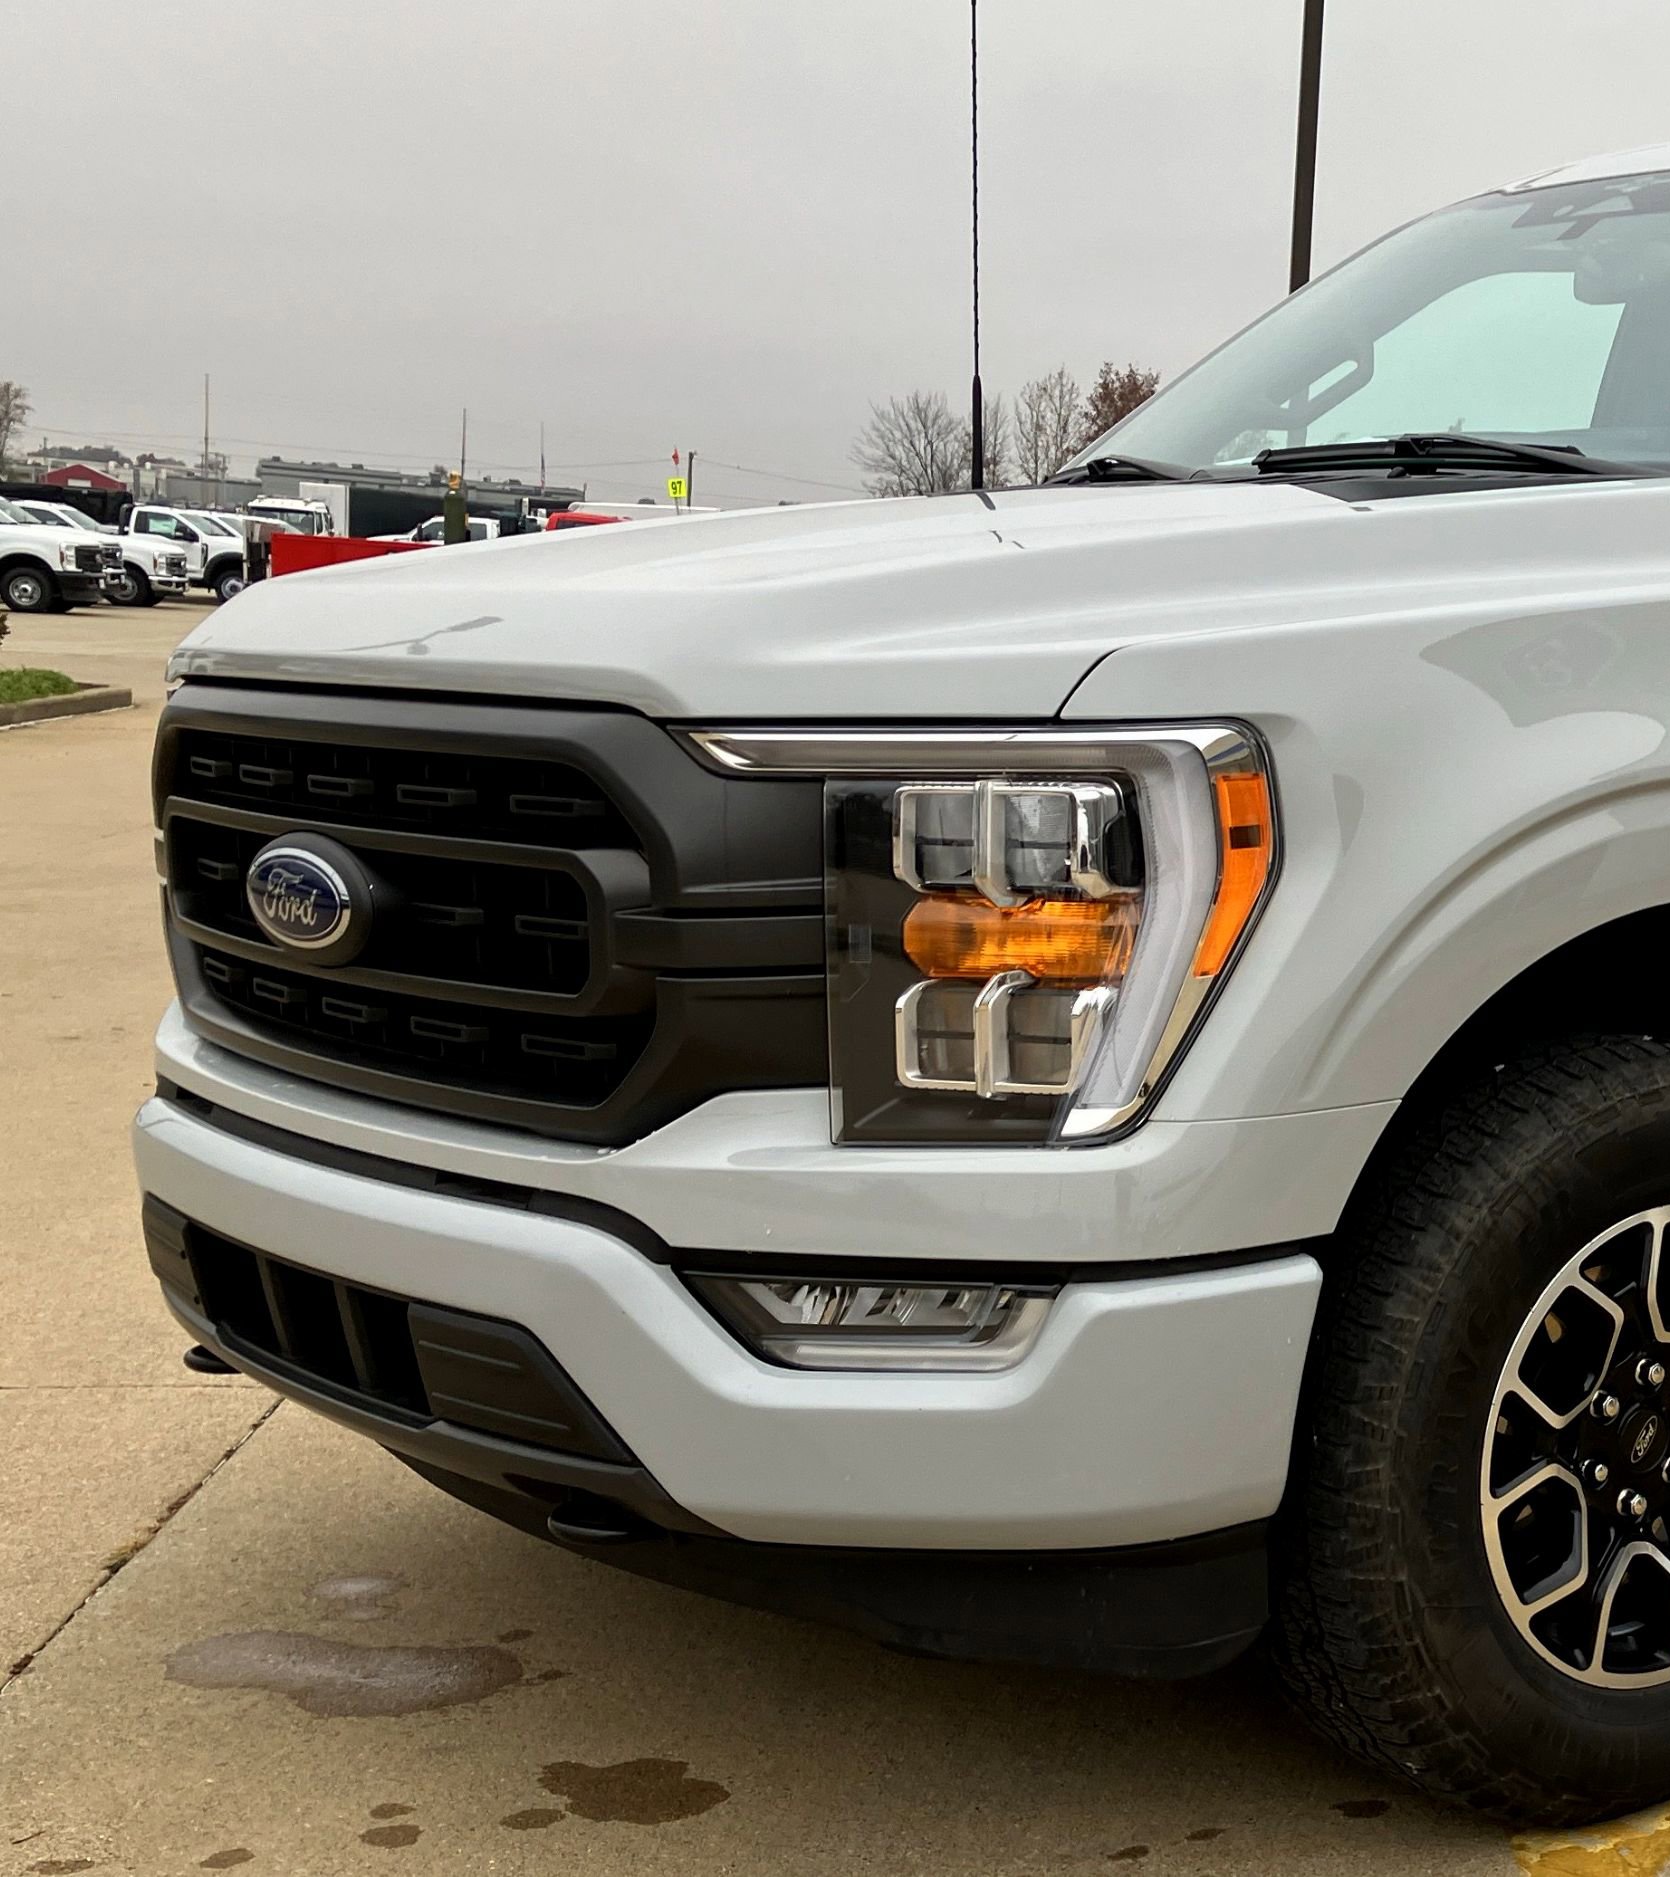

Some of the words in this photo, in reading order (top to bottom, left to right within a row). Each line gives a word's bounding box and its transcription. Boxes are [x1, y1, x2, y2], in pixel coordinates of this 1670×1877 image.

[671, 480, 682, 496] 97
[263, 867, 318, 926] Ford
[1635, 1422, 1655, 1457] Ford
